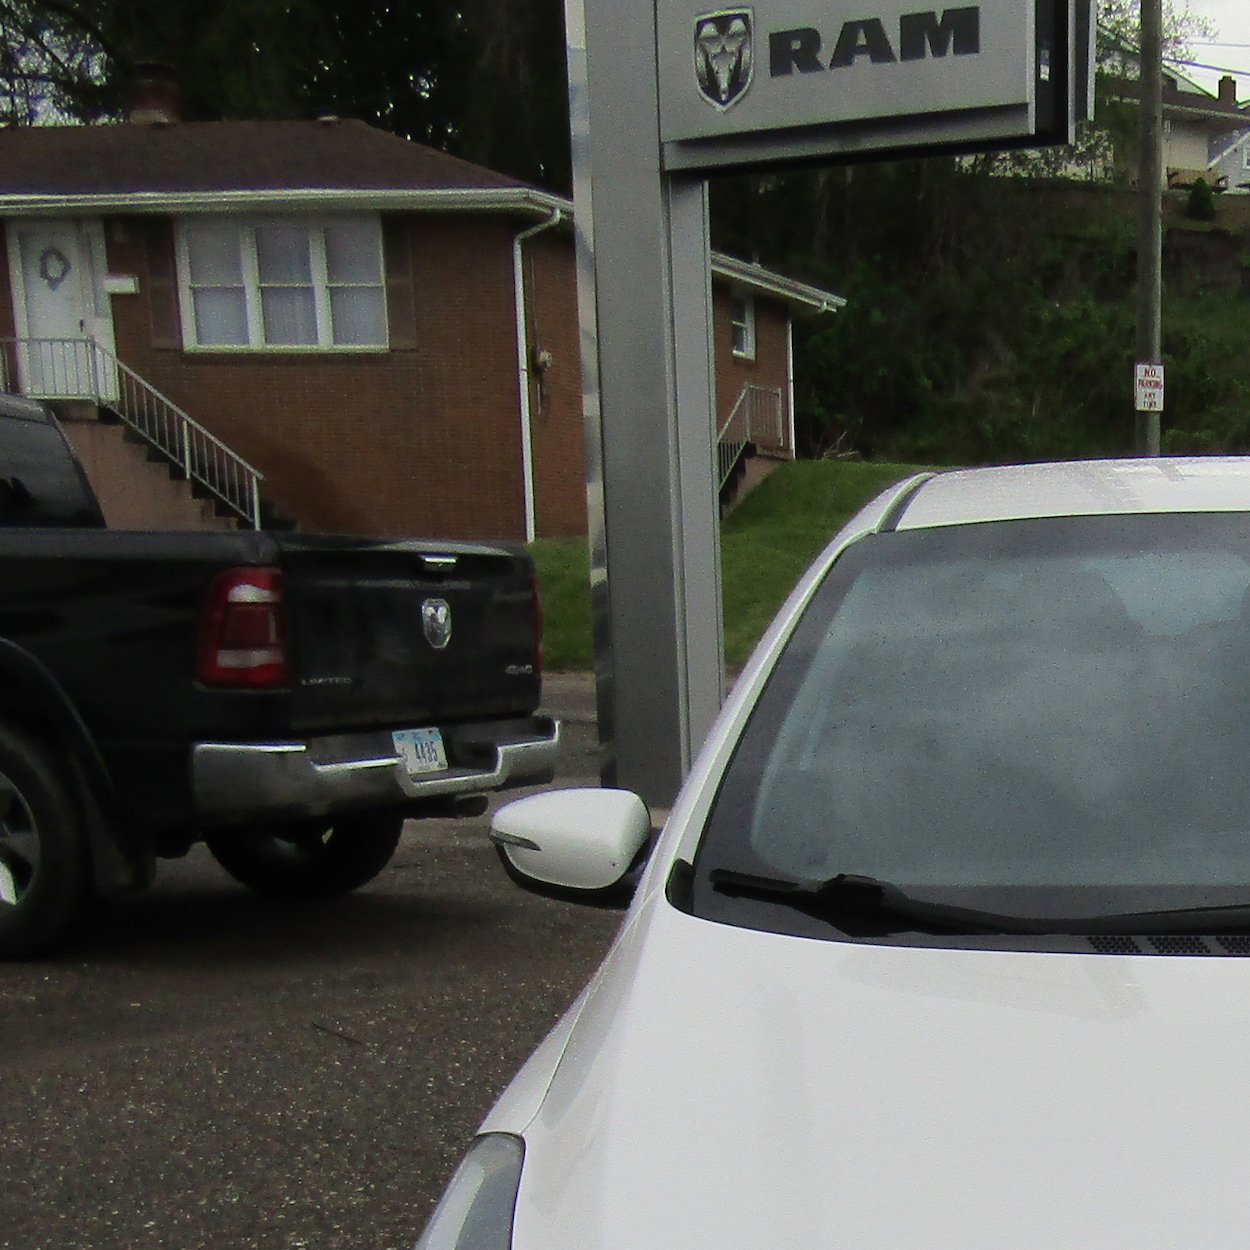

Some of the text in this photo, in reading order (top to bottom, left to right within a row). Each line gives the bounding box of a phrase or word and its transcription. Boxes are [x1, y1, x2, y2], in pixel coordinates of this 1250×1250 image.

[769, 6, 980, 78] RAM
[1144, 368, 1156, 377] NO
[1138, 379, 1163, 389] PARKING
